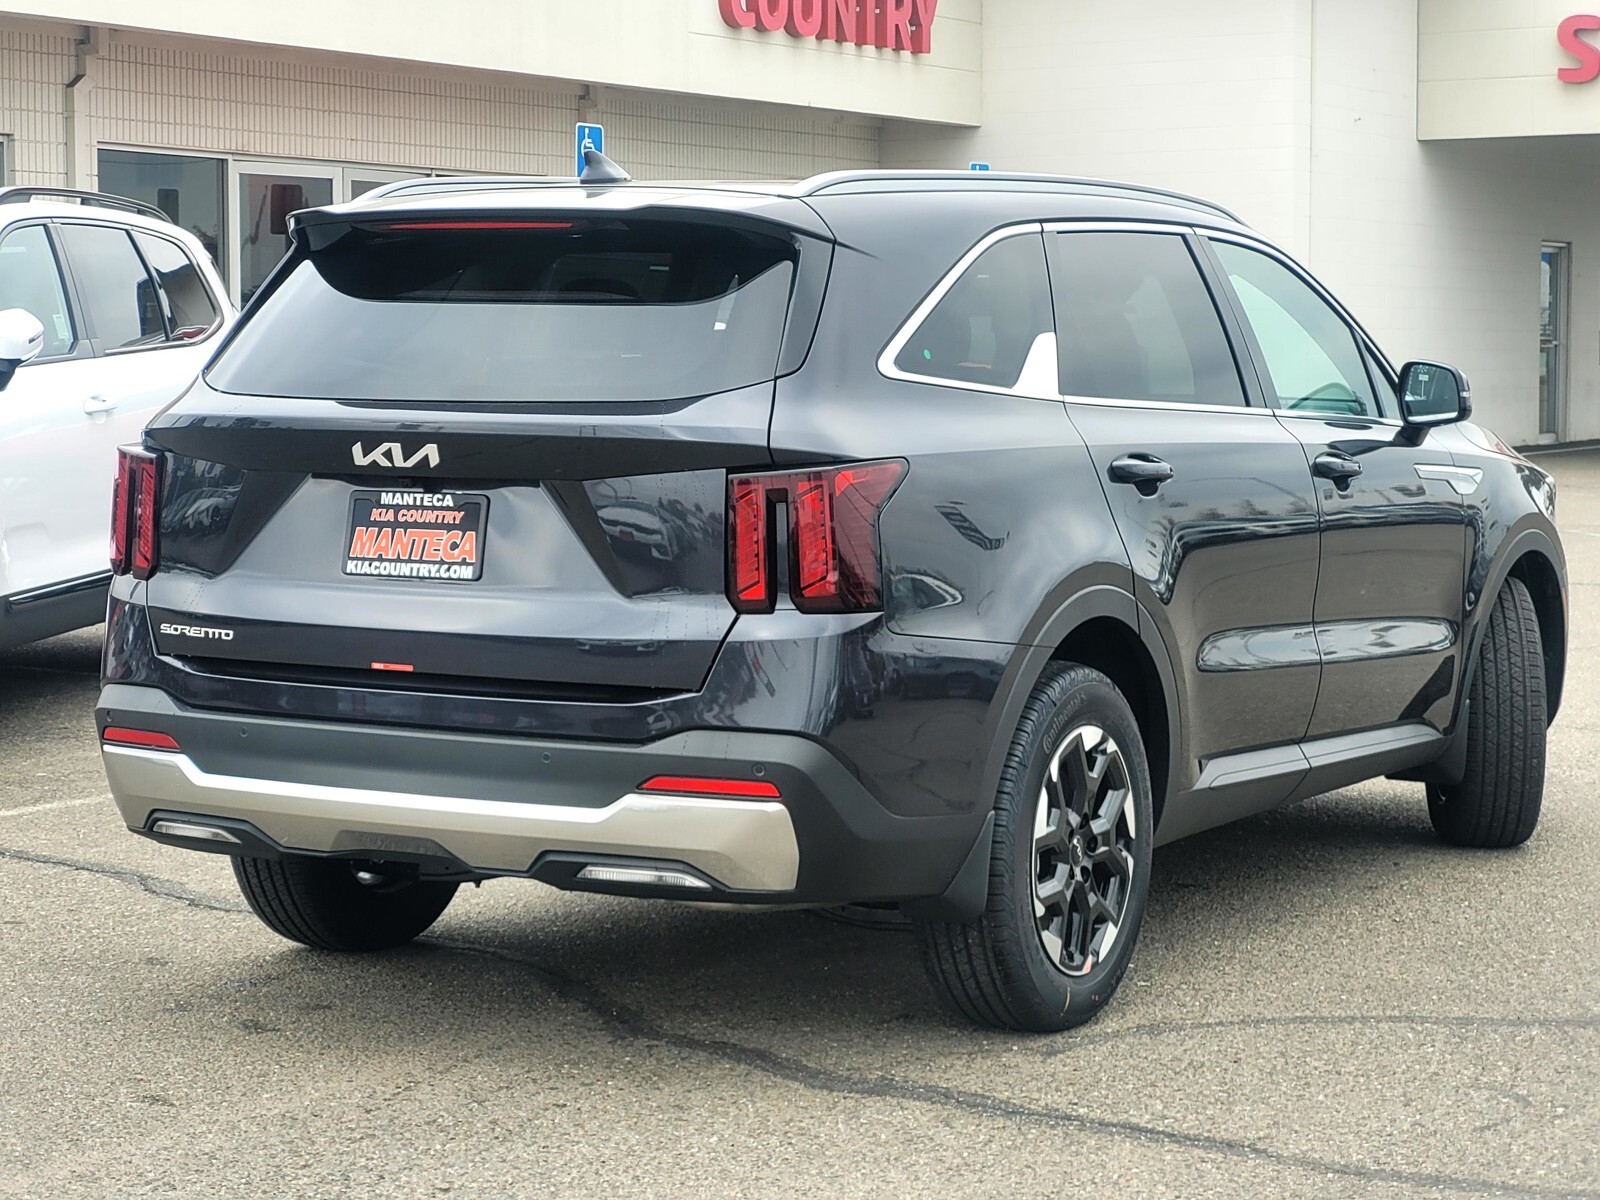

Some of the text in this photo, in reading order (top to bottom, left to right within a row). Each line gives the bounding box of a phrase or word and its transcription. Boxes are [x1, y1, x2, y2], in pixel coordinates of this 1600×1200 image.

[351, 441, 440, 468] KIA
[380, 492, 454, 507] MANTECA
[370, 508, 465, 524] KIA COUNTRY
[349, 526, 476, 563] MANTECA
[346, 560, 474, 579] KIACOUNTRY.COM
[160, 623, 234, 640] SORENTO
